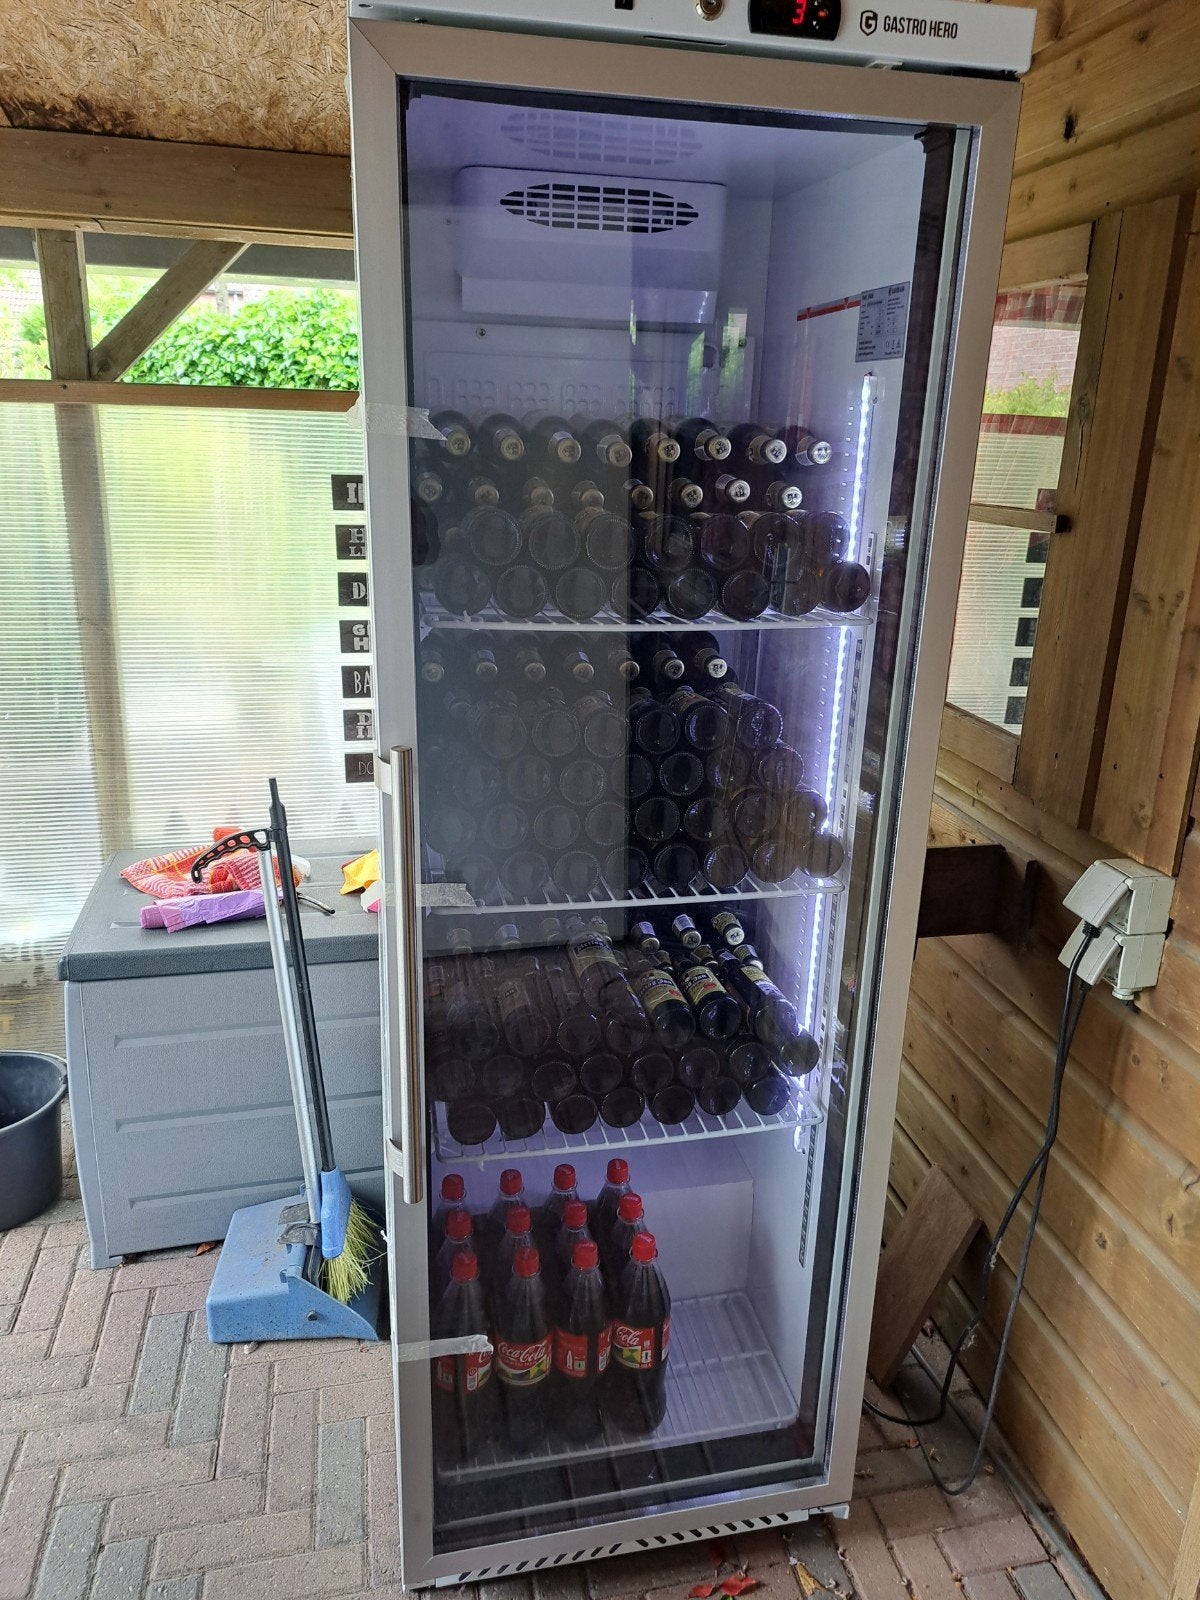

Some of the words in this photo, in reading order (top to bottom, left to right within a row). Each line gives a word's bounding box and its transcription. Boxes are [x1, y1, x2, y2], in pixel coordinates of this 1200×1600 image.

[883, 15, 927, 36] GASTRO
[928, 20, 958, 39] HERO
[616, 1326, 643, 1346] Cola
